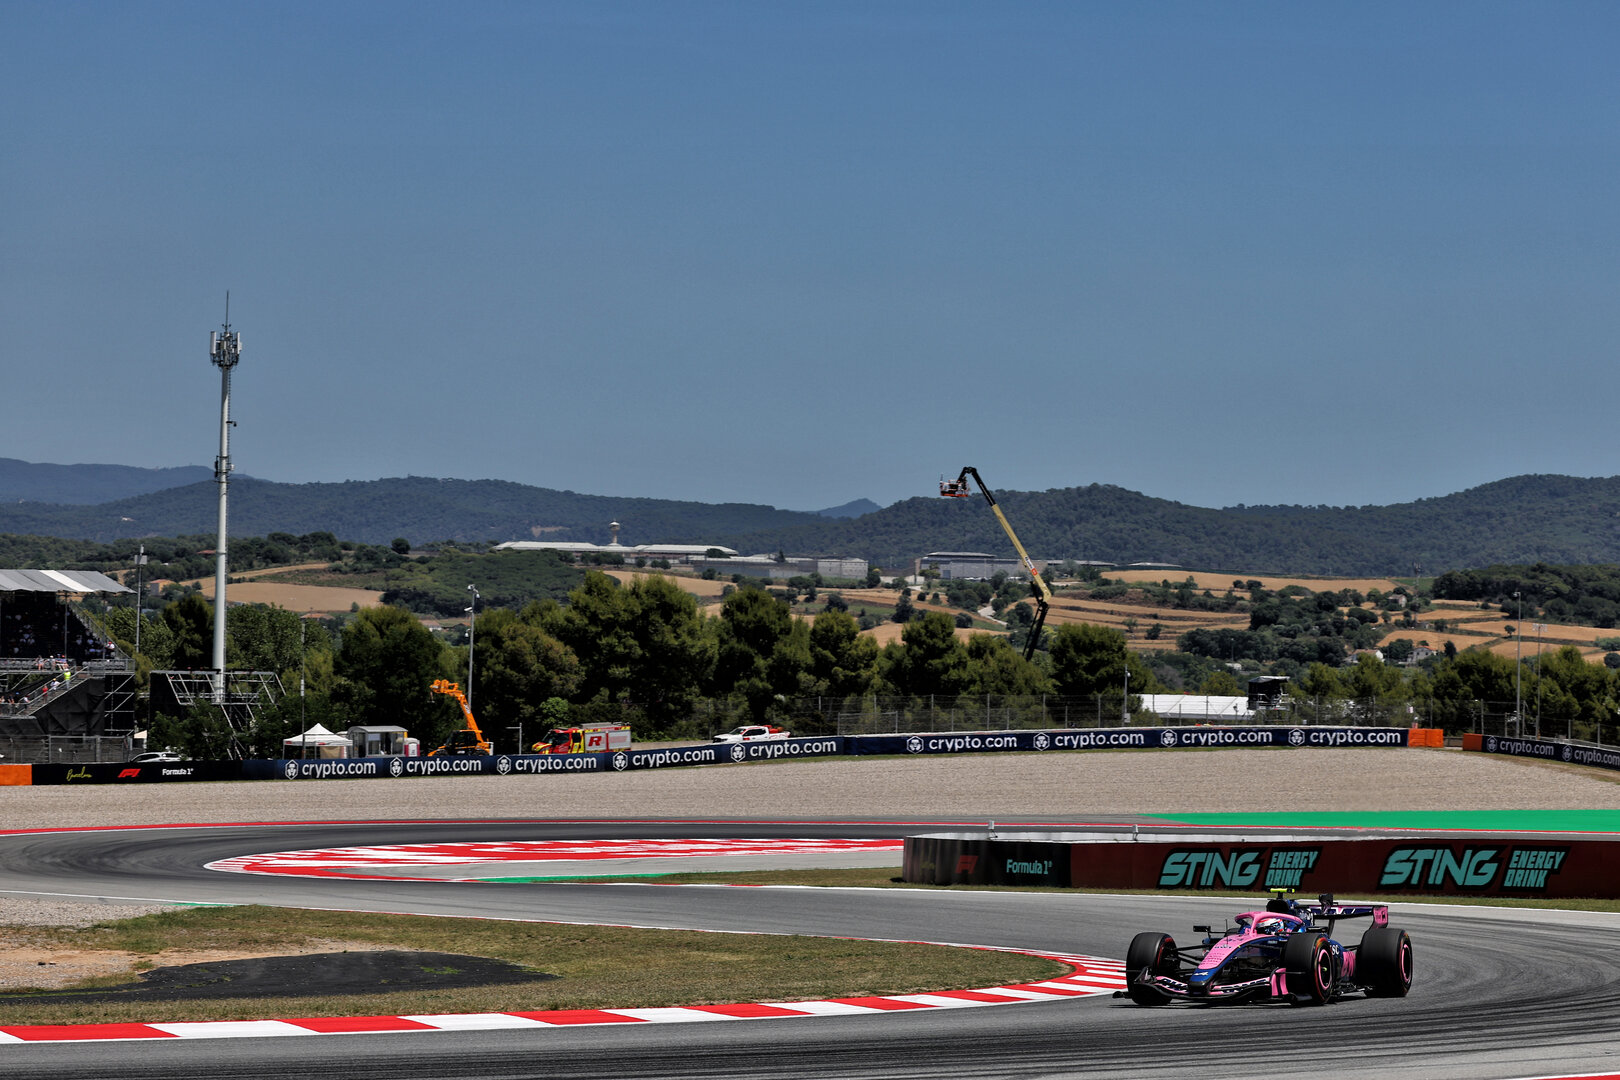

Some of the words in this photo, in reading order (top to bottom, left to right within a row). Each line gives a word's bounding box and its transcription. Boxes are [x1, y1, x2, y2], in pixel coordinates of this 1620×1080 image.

[588, 736, 602, 747] R
[928, 735, 1018, 751] crypto.com
[1054, 733, 1145, 749] crypto.com
[1181, 731, 1273, 747] crypto.com
[1309, 730, 1401, 747] crypto.com
[749, 739, 837, 758] crypto.com
[1499, 740, 1554, 755] crypto.com
[515, 756, 597, 773] crypto.com
[632, 748, 715, 765] crypto.com
[162, 768, 186, 776] Formula
[302, 760, 376, 778] crypto.com
[406, 757, 482, 775] crypto.com
[1006, 859, 1043, 875] Formula
[1269, 851, 1319, 869] ENERGY
[1380, 849, 1498, 886] STING
[1509, 851, 1566, 869] ENERGY
[1159, 852, 1261, 886] STING
[1265, 869, 1303, 886] DRINK
[1503, 870, 1548, 888] DRINK
